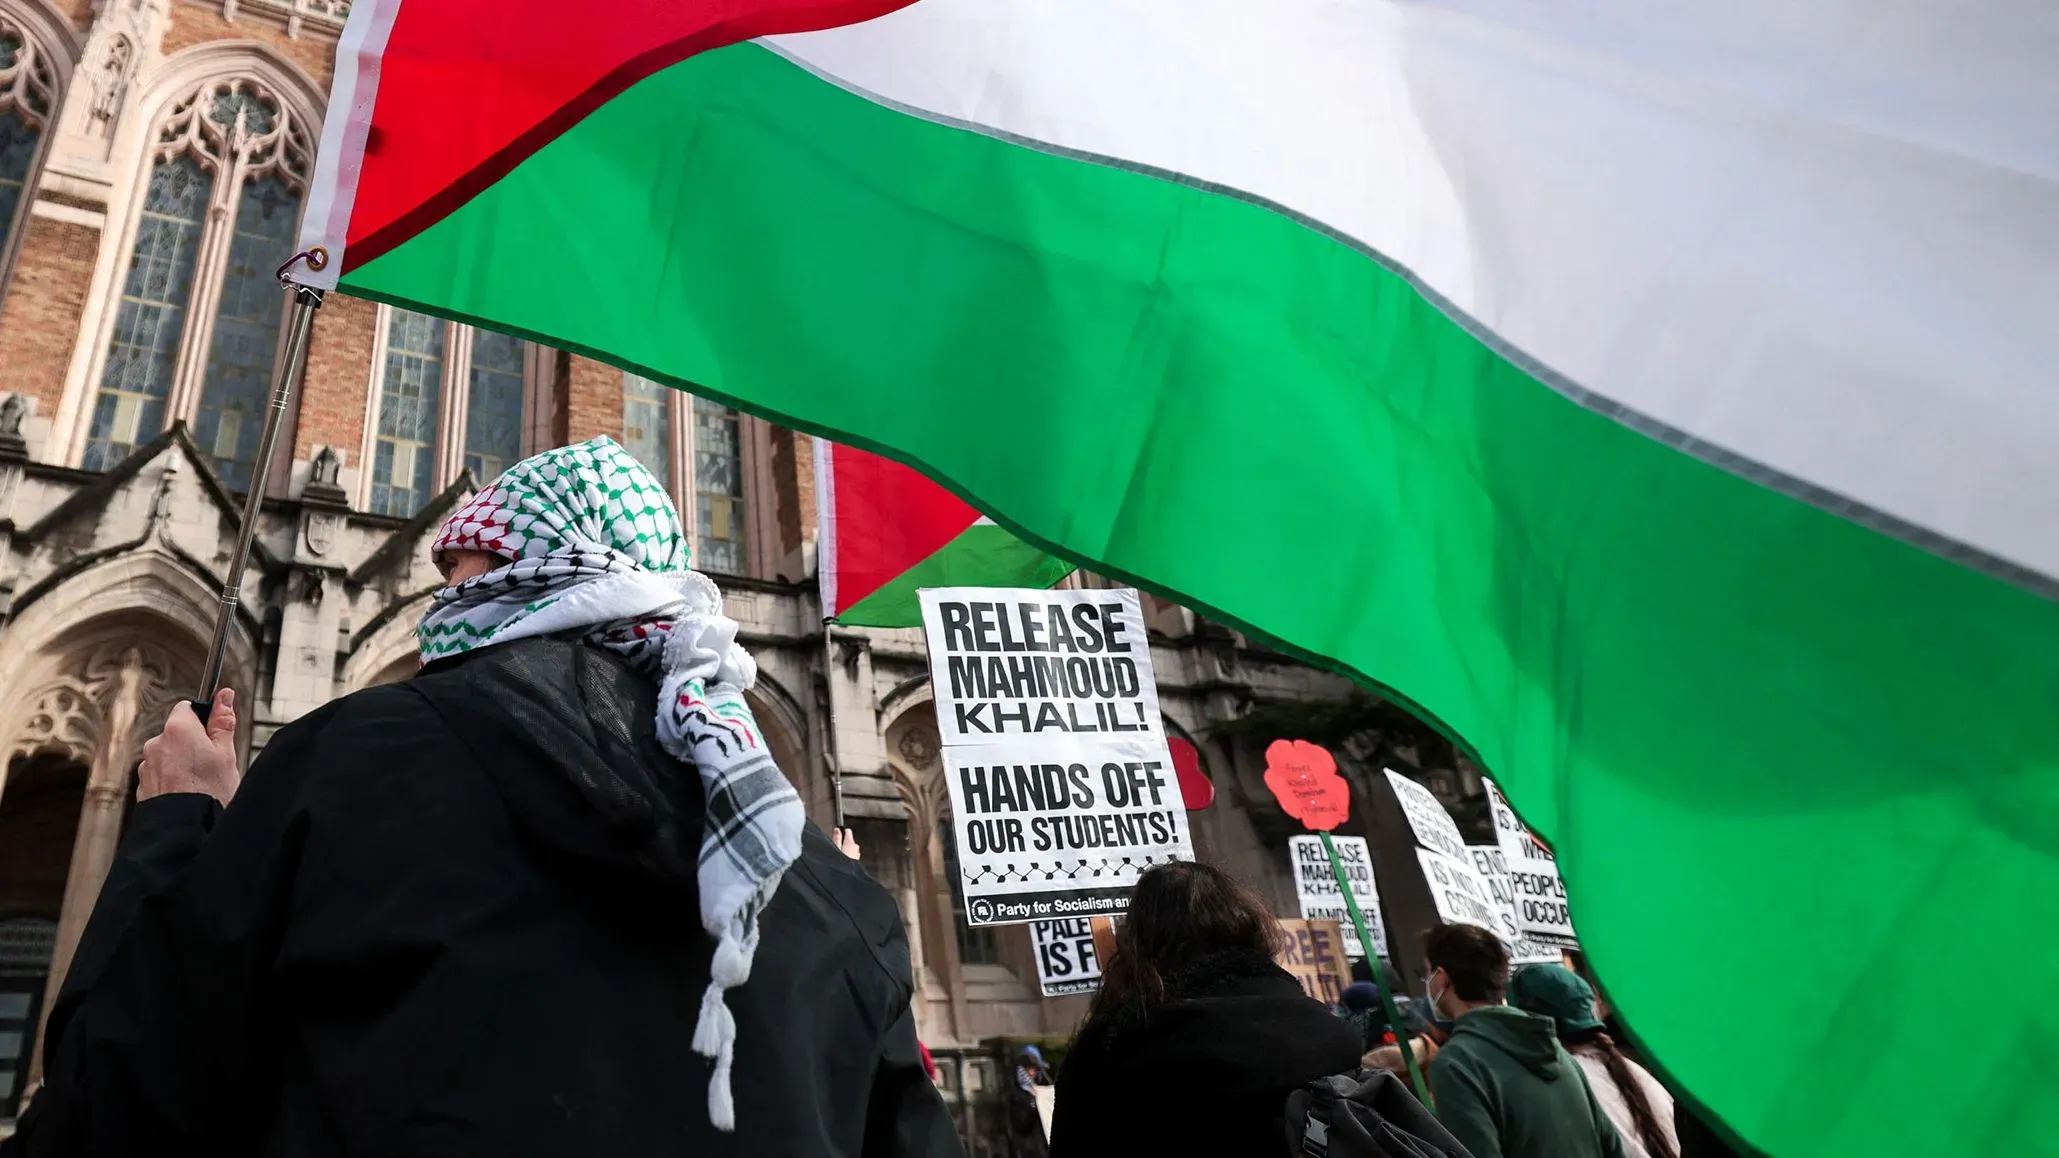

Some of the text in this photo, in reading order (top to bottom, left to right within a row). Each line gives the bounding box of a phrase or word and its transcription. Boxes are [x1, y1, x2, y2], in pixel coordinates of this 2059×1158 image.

[939, 602, 1131, 653] RELEASE
[949, 656, 1140, 699] MAHMOUD
[956, 702, 1148, 734] KHALIL!
[960, 761, 1165, 813] HANDS OFF
[967, 811, 1178, 854] OUR STUDENTS!
[1297, 843, 1363, 862] RELASE
[1302, 864, 1368, 881] MAHOUD
[1429, 859, 1449, 885] IS
[1304, 883, 1371, 896] KHAIL!
[997, 903, 1031, 918] Party
[1033, 902, 1051, 914] for
[1054, 897, 1112, 912] Socialism
[1114, 897, 1131, 908] an
[1040, 942, 1072, 978] IS
[1283, 929, 1333, 964] REE
